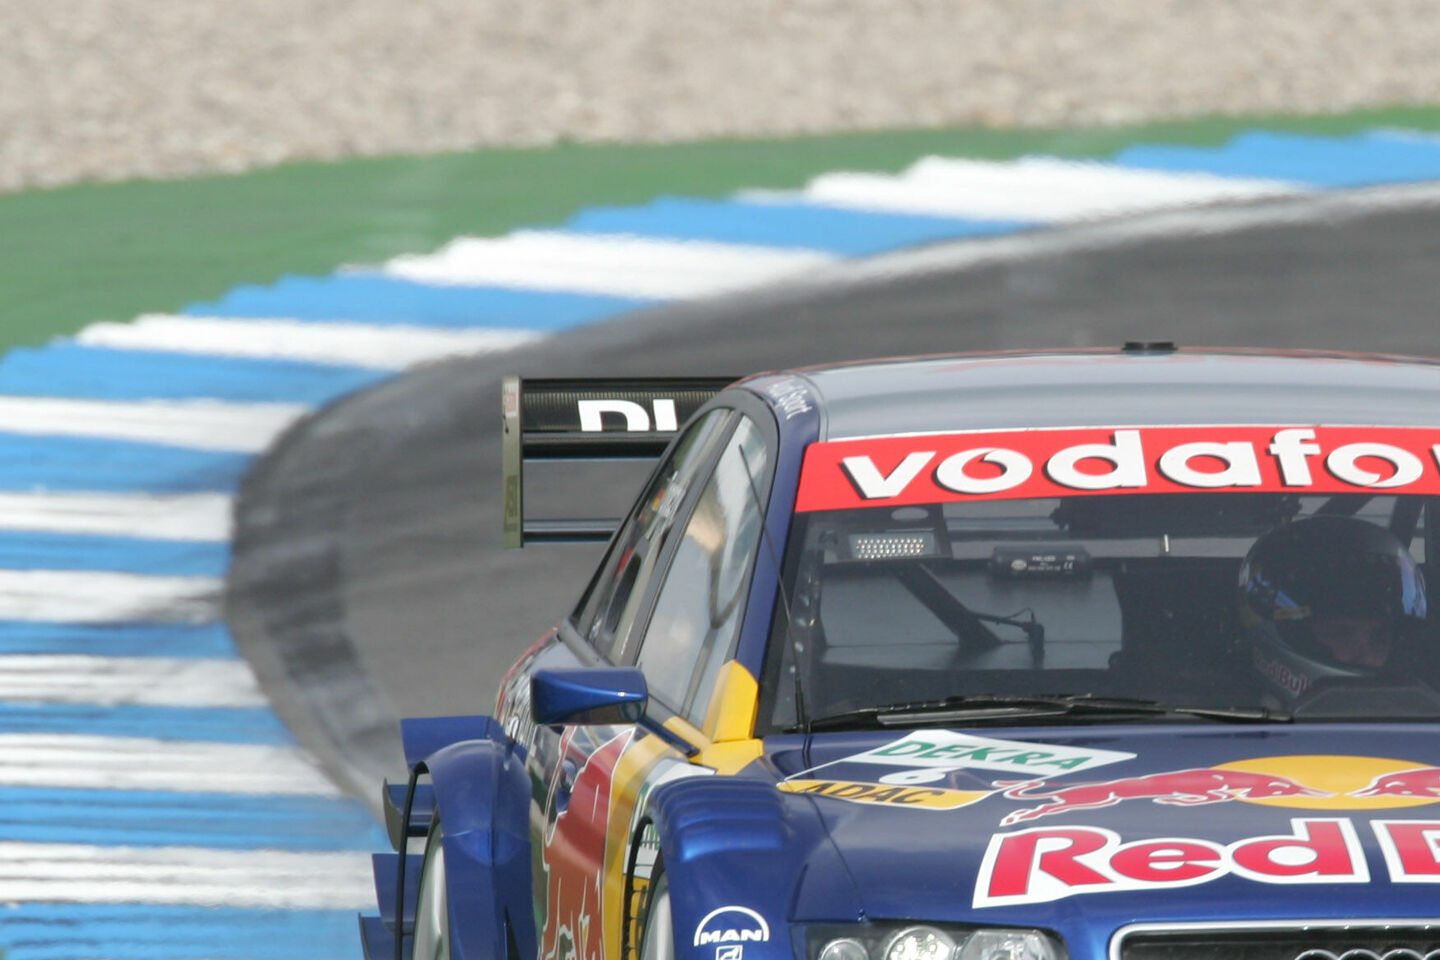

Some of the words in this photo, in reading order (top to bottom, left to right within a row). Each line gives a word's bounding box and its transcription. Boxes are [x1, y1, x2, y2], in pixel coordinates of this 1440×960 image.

[870, 740, 1093, 770] DEKRA
[805, 782, 944, 804] ADAC
[972, 816, 1370, 909] Red
[700, 930, 763, 943] MAN
